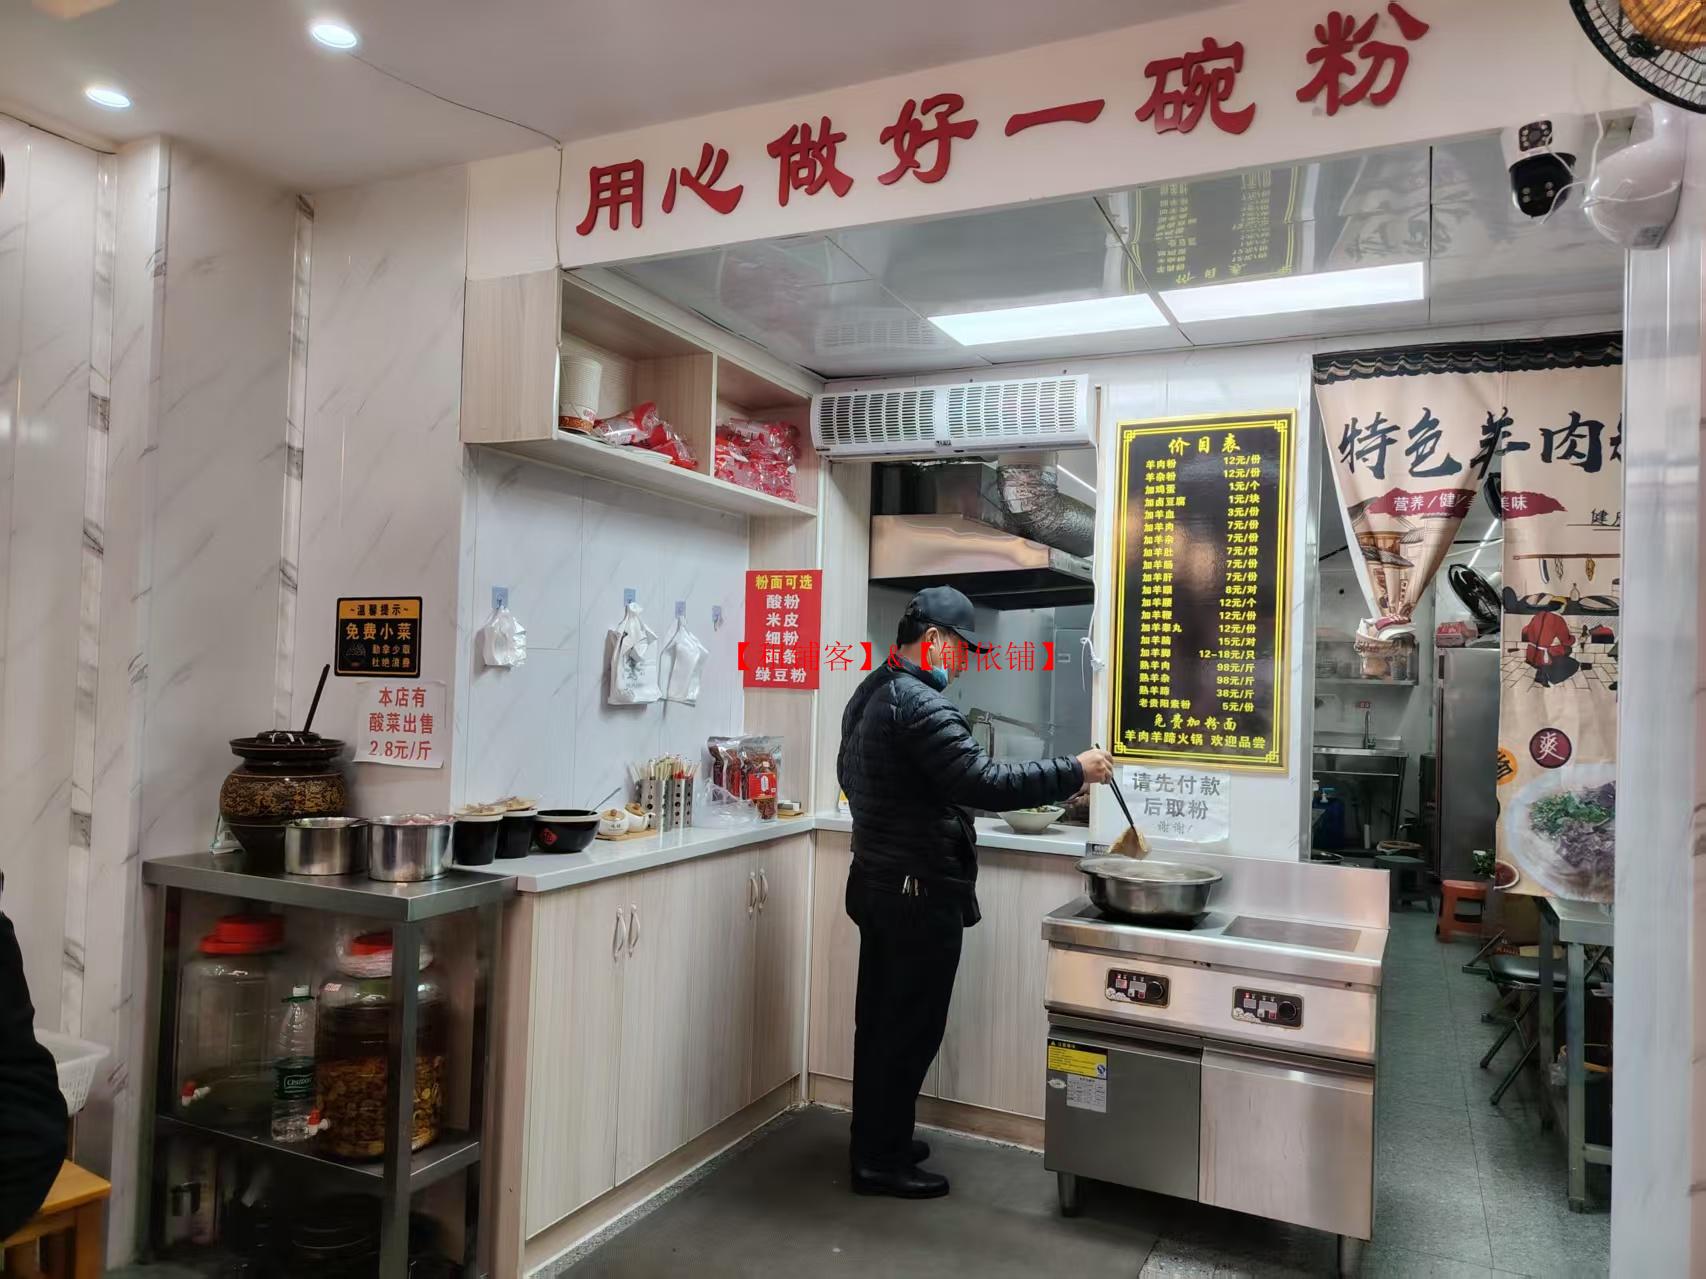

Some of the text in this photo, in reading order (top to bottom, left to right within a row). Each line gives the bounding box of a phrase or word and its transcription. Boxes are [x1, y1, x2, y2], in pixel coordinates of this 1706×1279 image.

[577, 5, 1427, 235] 用心做好一碗粉
[1167, 432, 1241, 455] 价目表
[1145, 453, 1261, 471] 羊肉粉 12元/份
[1144, 466, 1262, 484] 羊杂粉 12元/份
[1144, 480, 1260, 496] 加鸡蛋 1元/个
[1143, 496, 1187, 508] 加卤豆腐
[1142, 508, 1176, 521] 加羊血
[1142, 519, 1260, 534] 加羊肉 7元/份
[1142, 532, 1260, 546] 加羊杂 7元/份
[1142, 545, 1259, 558] 加羊肚 7元/份
[1226, 558, 1259, 570] 7元/份
[755, 574, 813, 590] 粉面可选
[1141, 571, 1259, 584] 加羊肝 7元/份
[766, 594, 800, 610] 酸粉
[1219, 597, 1257, 609] 12元/个
[766, 612, 799, 628] 米皮
[1219, 610, 1257, 621] 12元/份
[346, 622, 412, 640] 免费小菜
[1218, 623, 1257, 634] 12元/份
[765, 630, 799, 646] 细粉
[1217, 636, 1257, 648] 15元/对
[765, 648, 798, 665] 面条
[1199, 649, 1255, 660] 12-18元/只
[1139, 659, 1255, 673] 熟羊肉 98元/斤
[755, 666, 807, 683] 绿豆粉
[1139, 672, 1254, 686] 熟羊杂 98元/斤
[378, 686, 427, 708] 本店有
[1215, 688, 1254, 699] 38元/斤
[1221, 701, 1255, 713] 5元/份
[368, 712, 433, 735] 酸菜出售
[1154, 713, 1237, 733] 免费加粉面
[1123, 727, 1266, 751] 羊肉羊蹄火锅 欢迎品尝
[1536, 732, 1566, 761] 爽
[368, 740, 433, 761] 2.8元/斤
[1132, 772, 1221, 796] 请先付款
[1144, 797, 1209, 820] 后取粉
